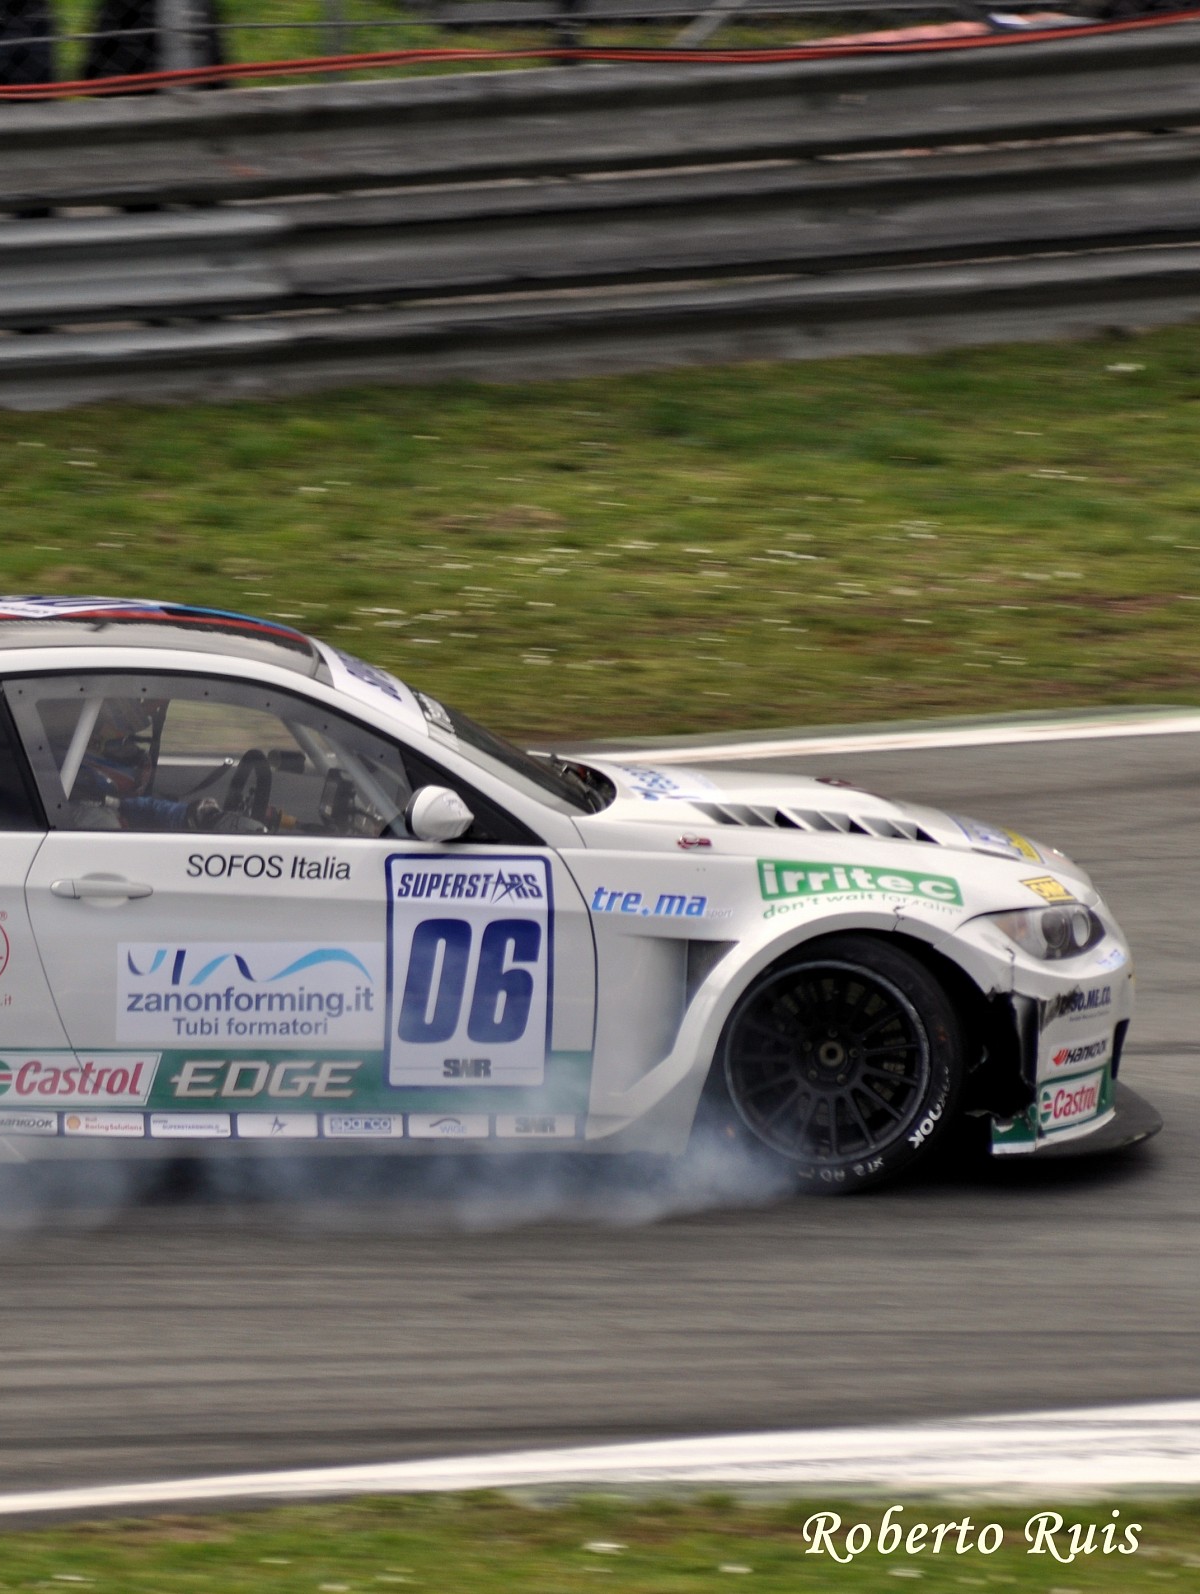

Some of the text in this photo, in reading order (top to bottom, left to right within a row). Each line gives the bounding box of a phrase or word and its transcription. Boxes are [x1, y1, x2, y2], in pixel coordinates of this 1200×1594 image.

[186, 854, 351, 880] SOFOS Italia
[762, 863, 956, 900] irritec
[397, 868, 543, 904] SUPERSTARS
[763, 896, 820, 920] don't
[827, 892, 876, 902] wait
[397, 918, 542, 1044] 06
[126, 986, 374, 1018] zanonforming.it
[173, 1017, 328, 1035] Tubi formatori
[15, 1060, 363, 1098] Castrol EDGE
[1053, 1080, 1099, 1119] Castrol
